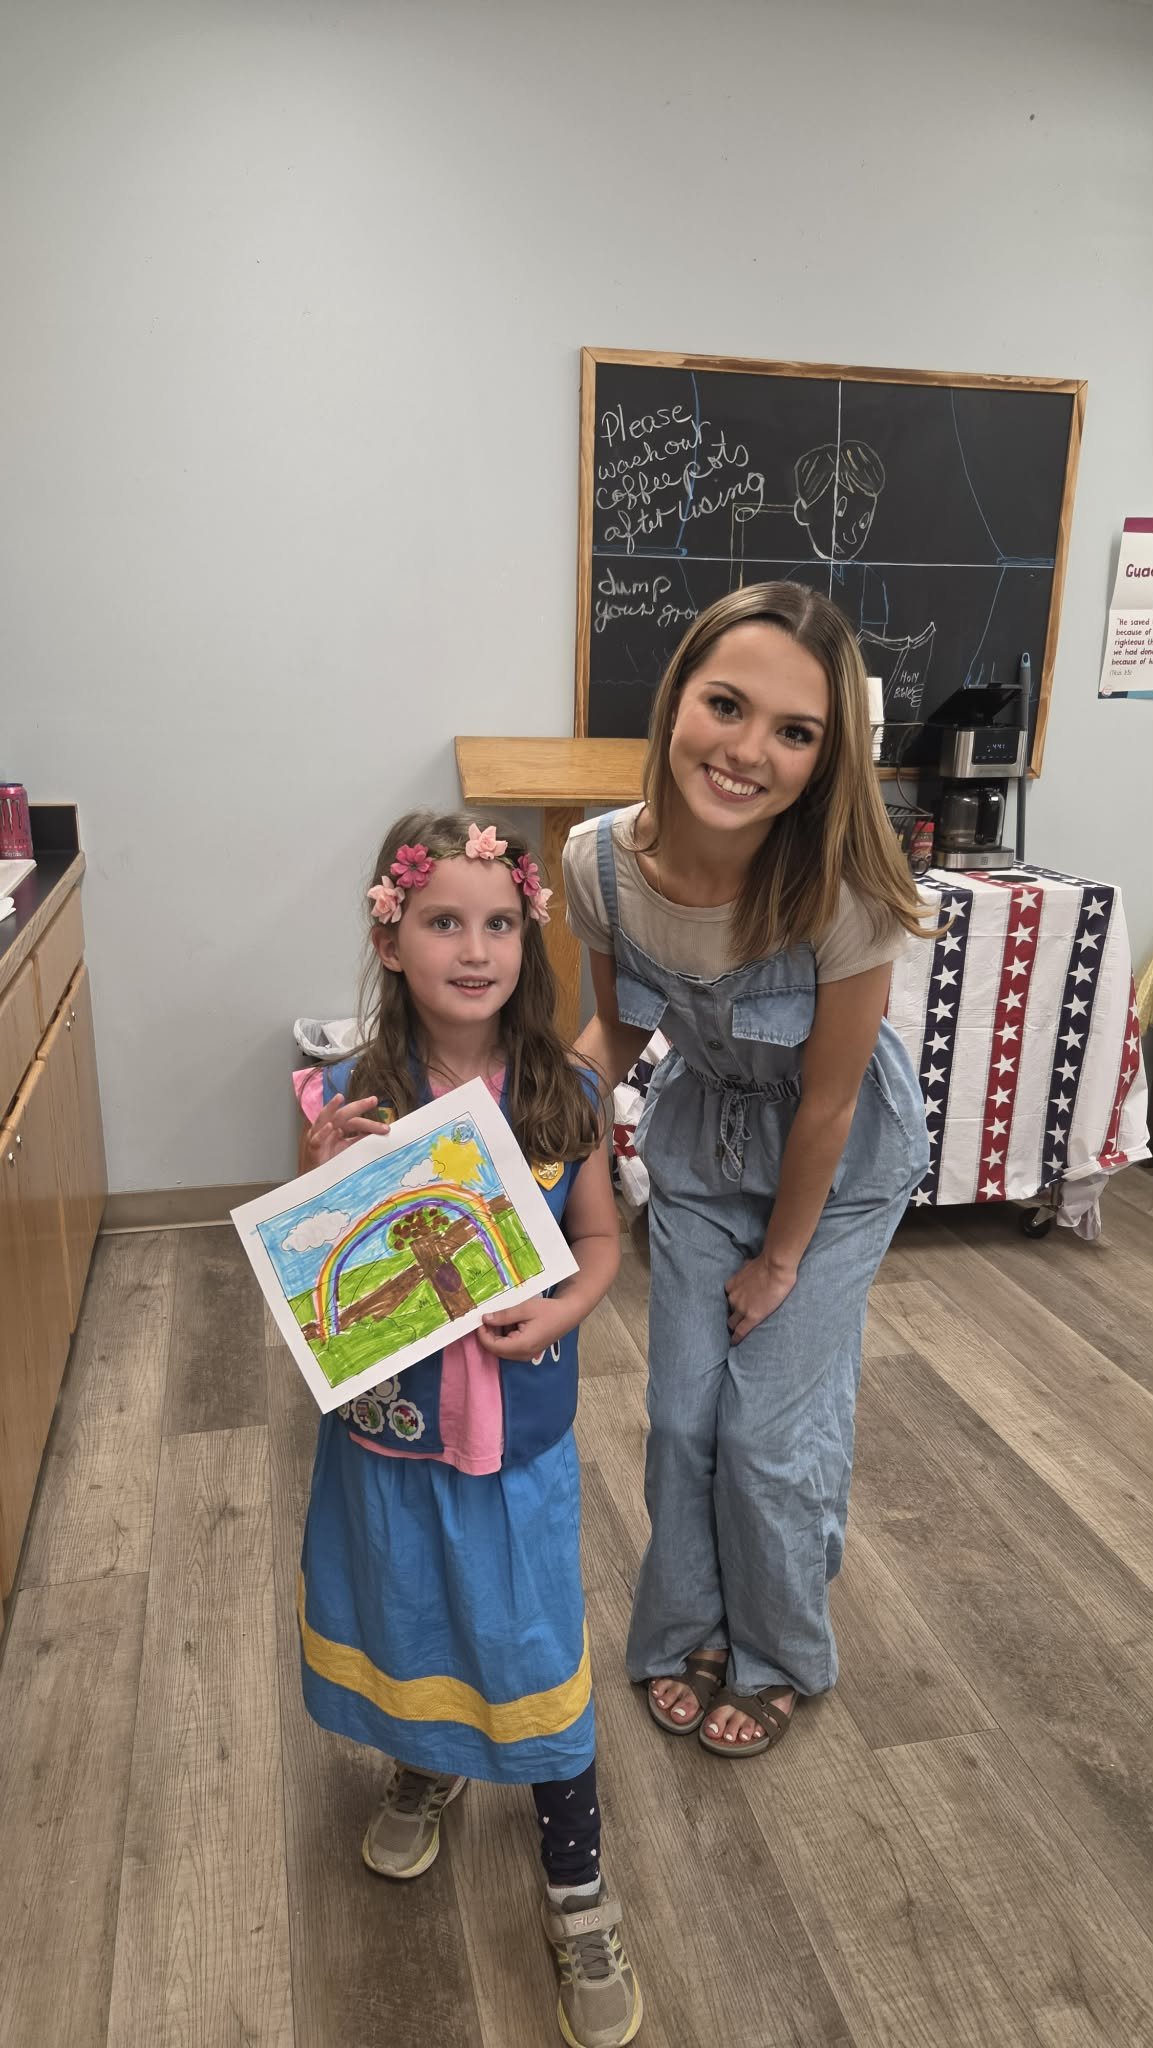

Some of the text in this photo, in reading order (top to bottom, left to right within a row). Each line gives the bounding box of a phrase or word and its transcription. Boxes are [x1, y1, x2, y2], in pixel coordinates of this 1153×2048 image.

[600, 403, 692, 447] Please
[604, 472, 765, 555] after using
[597, 568, 671, 602] dump
[1130, 617, 1150, 626] saved
[1115, 628, 1152, 636] because of
[1114, 638, 1145, 649] righteous
[1124, 648, 1138, 656] had
[1111, 658, 1137, 666] because
[1139, 657, 1147, 665] of
[574, 1914, 601, 1930] FILA
